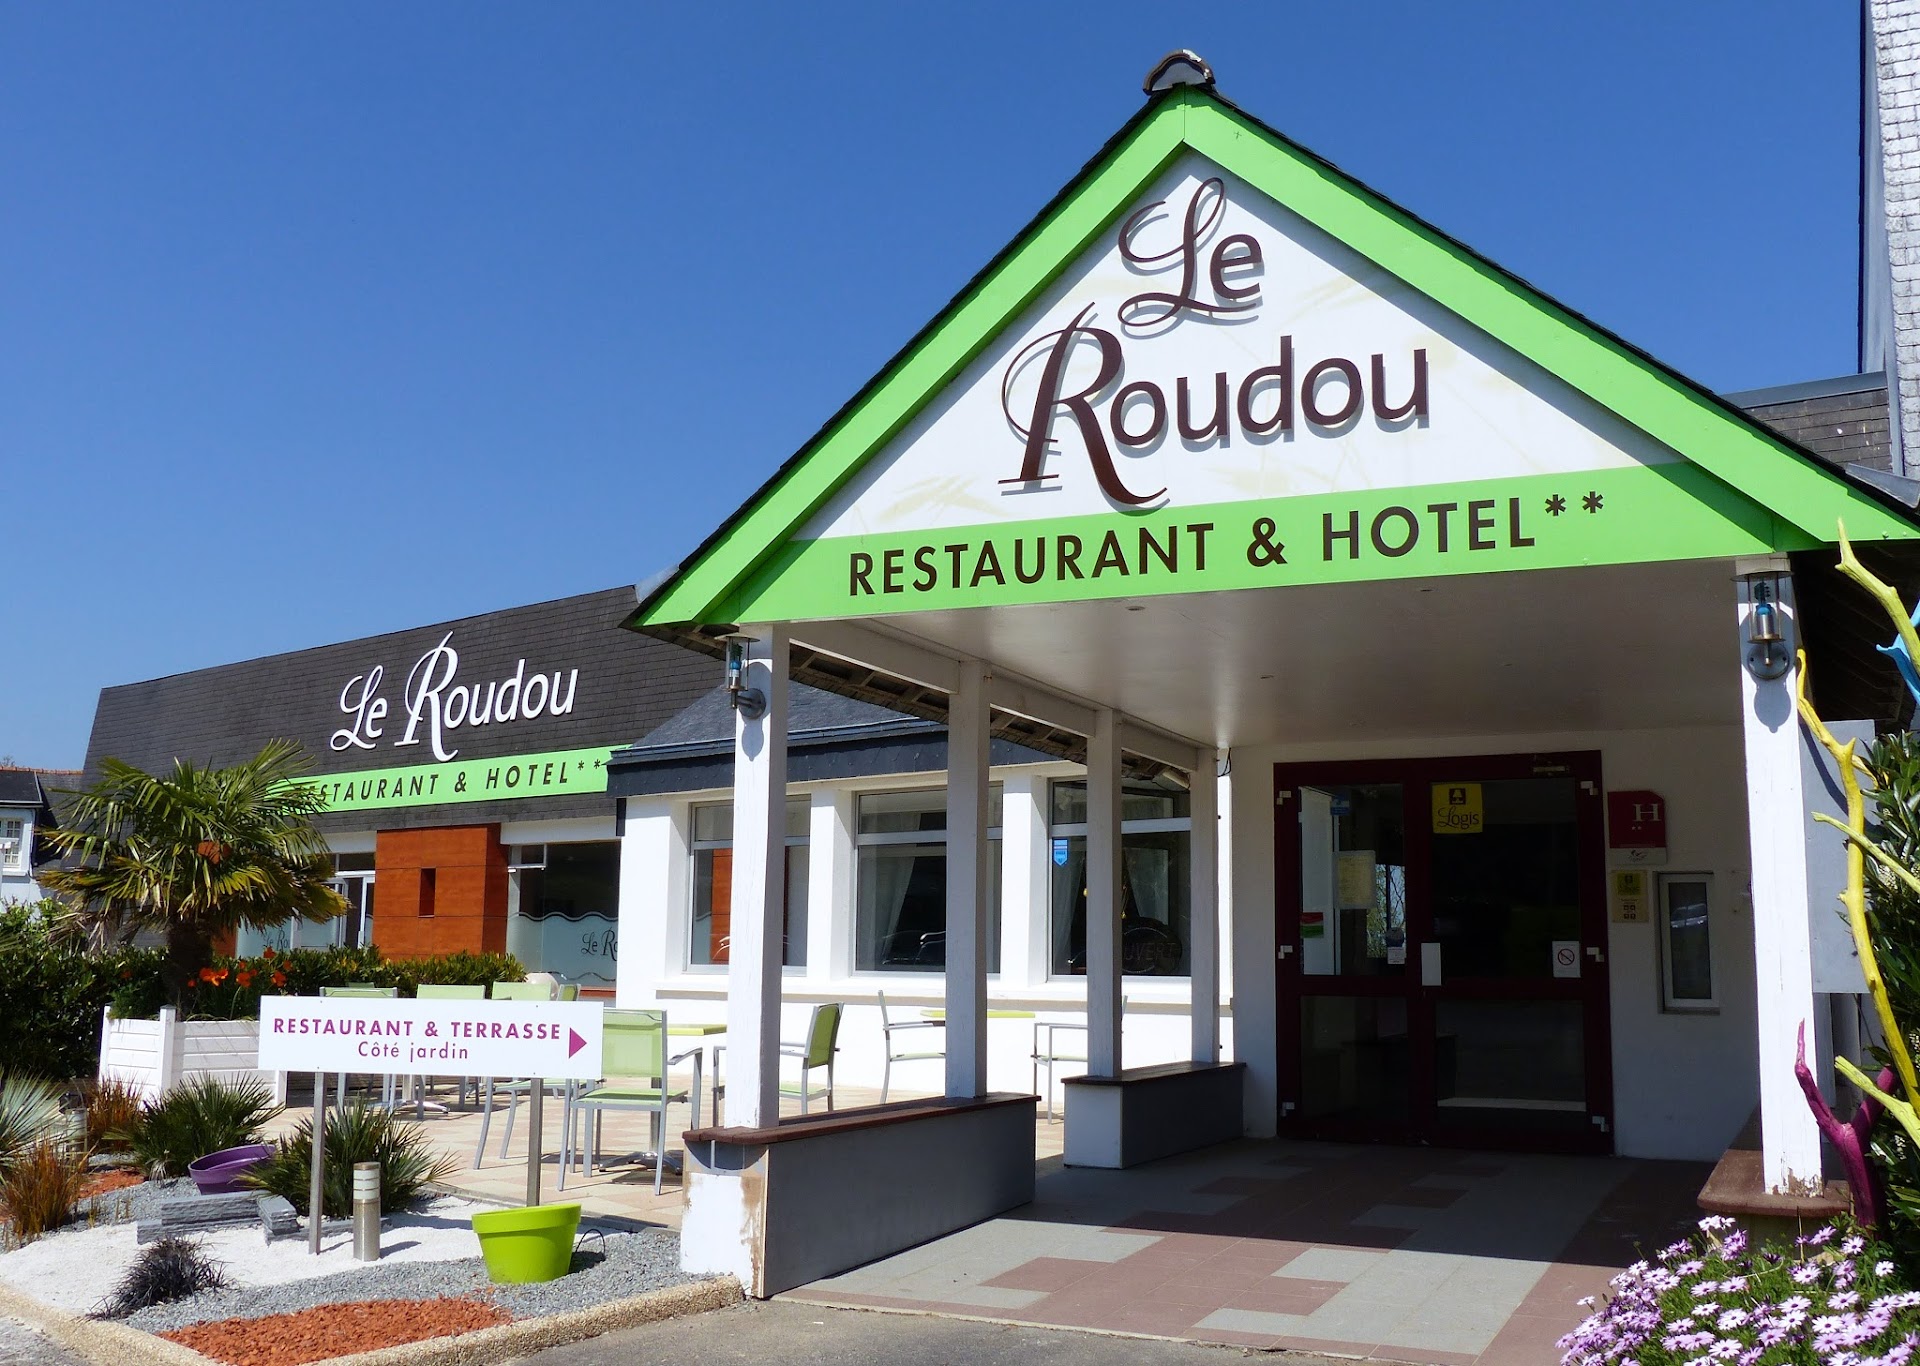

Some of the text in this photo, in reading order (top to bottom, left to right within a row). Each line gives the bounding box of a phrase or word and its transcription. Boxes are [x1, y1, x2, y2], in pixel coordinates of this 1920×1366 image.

[1117, 176, 1265, 328] Le
[998, 300, 1429, 506] Roudou
[849, 522, 1214, 597] RESTAURANT
[1246, 517, 1287, 568] &
[330, 630, 579, 762] Le Roudou
[294, 773, 439, 804] STAURANT
[453, 770, 467, 793] &
[1436, 805, 1480, 830] Logis
[1632, 802, 1662, 822] H
[580, 931, 598, 956] Le
[273, 1017, 561, 1040] RESTAURANT & TERRASSE
[358, 1040, 469, 1063] Côté jardin
